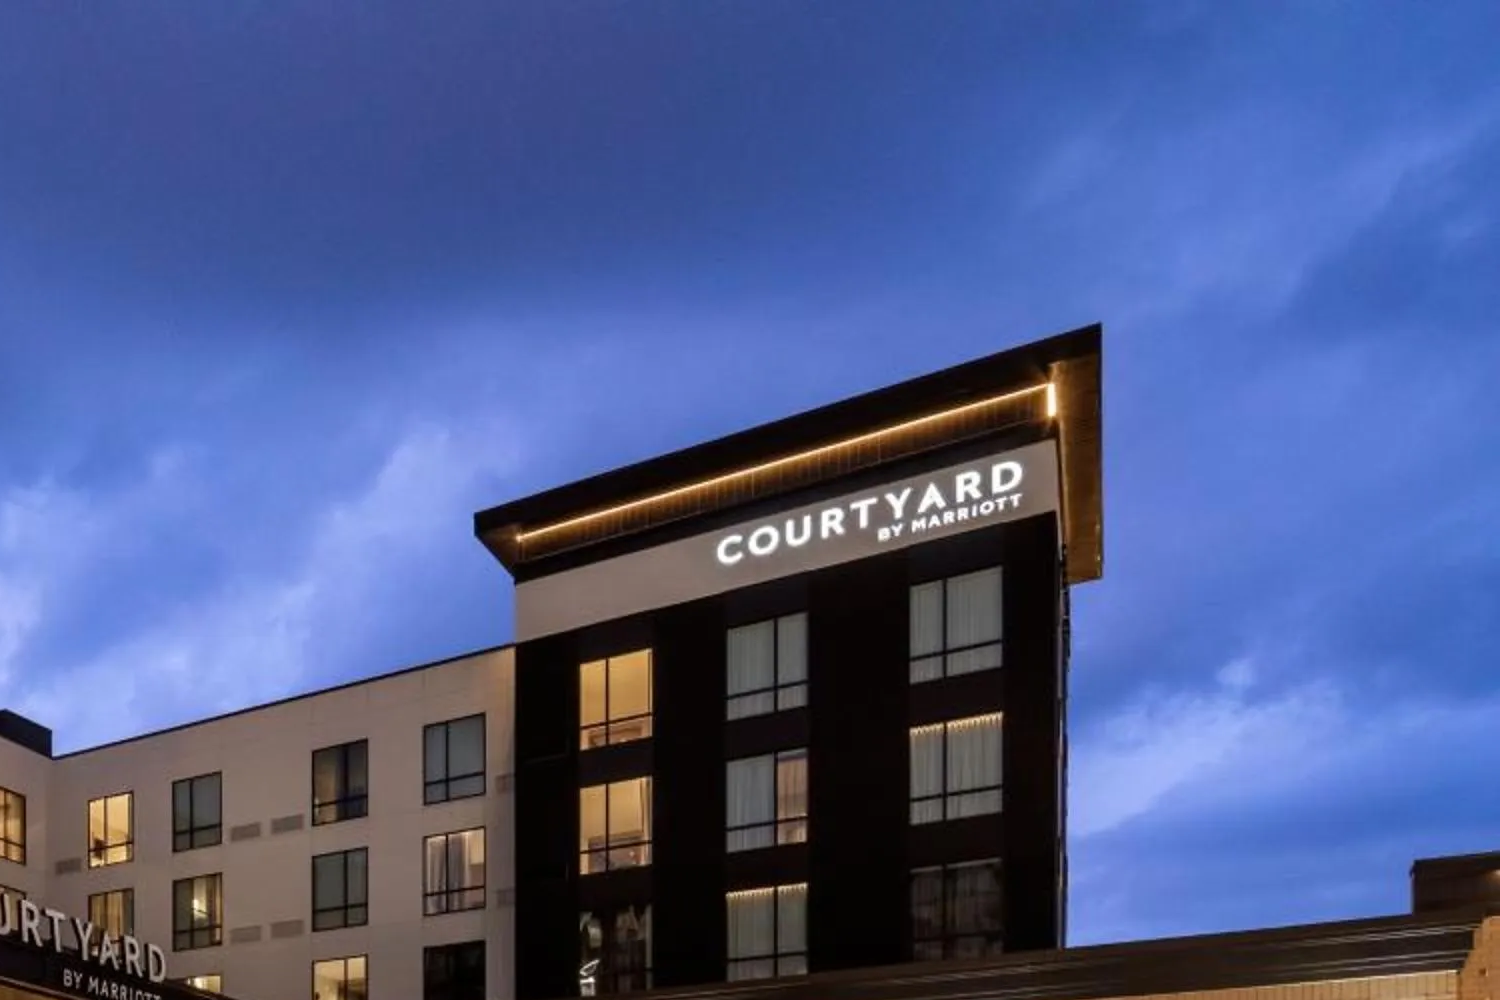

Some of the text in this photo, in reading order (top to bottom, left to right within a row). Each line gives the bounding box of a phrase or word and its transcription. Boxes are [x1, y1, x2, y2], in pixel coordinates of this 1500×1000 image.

[716, 461, 1023, 565] COURTYARD
[877, 493, 1023, 543] BY MARRIOTT
[63, 968, 83, 990] BY
